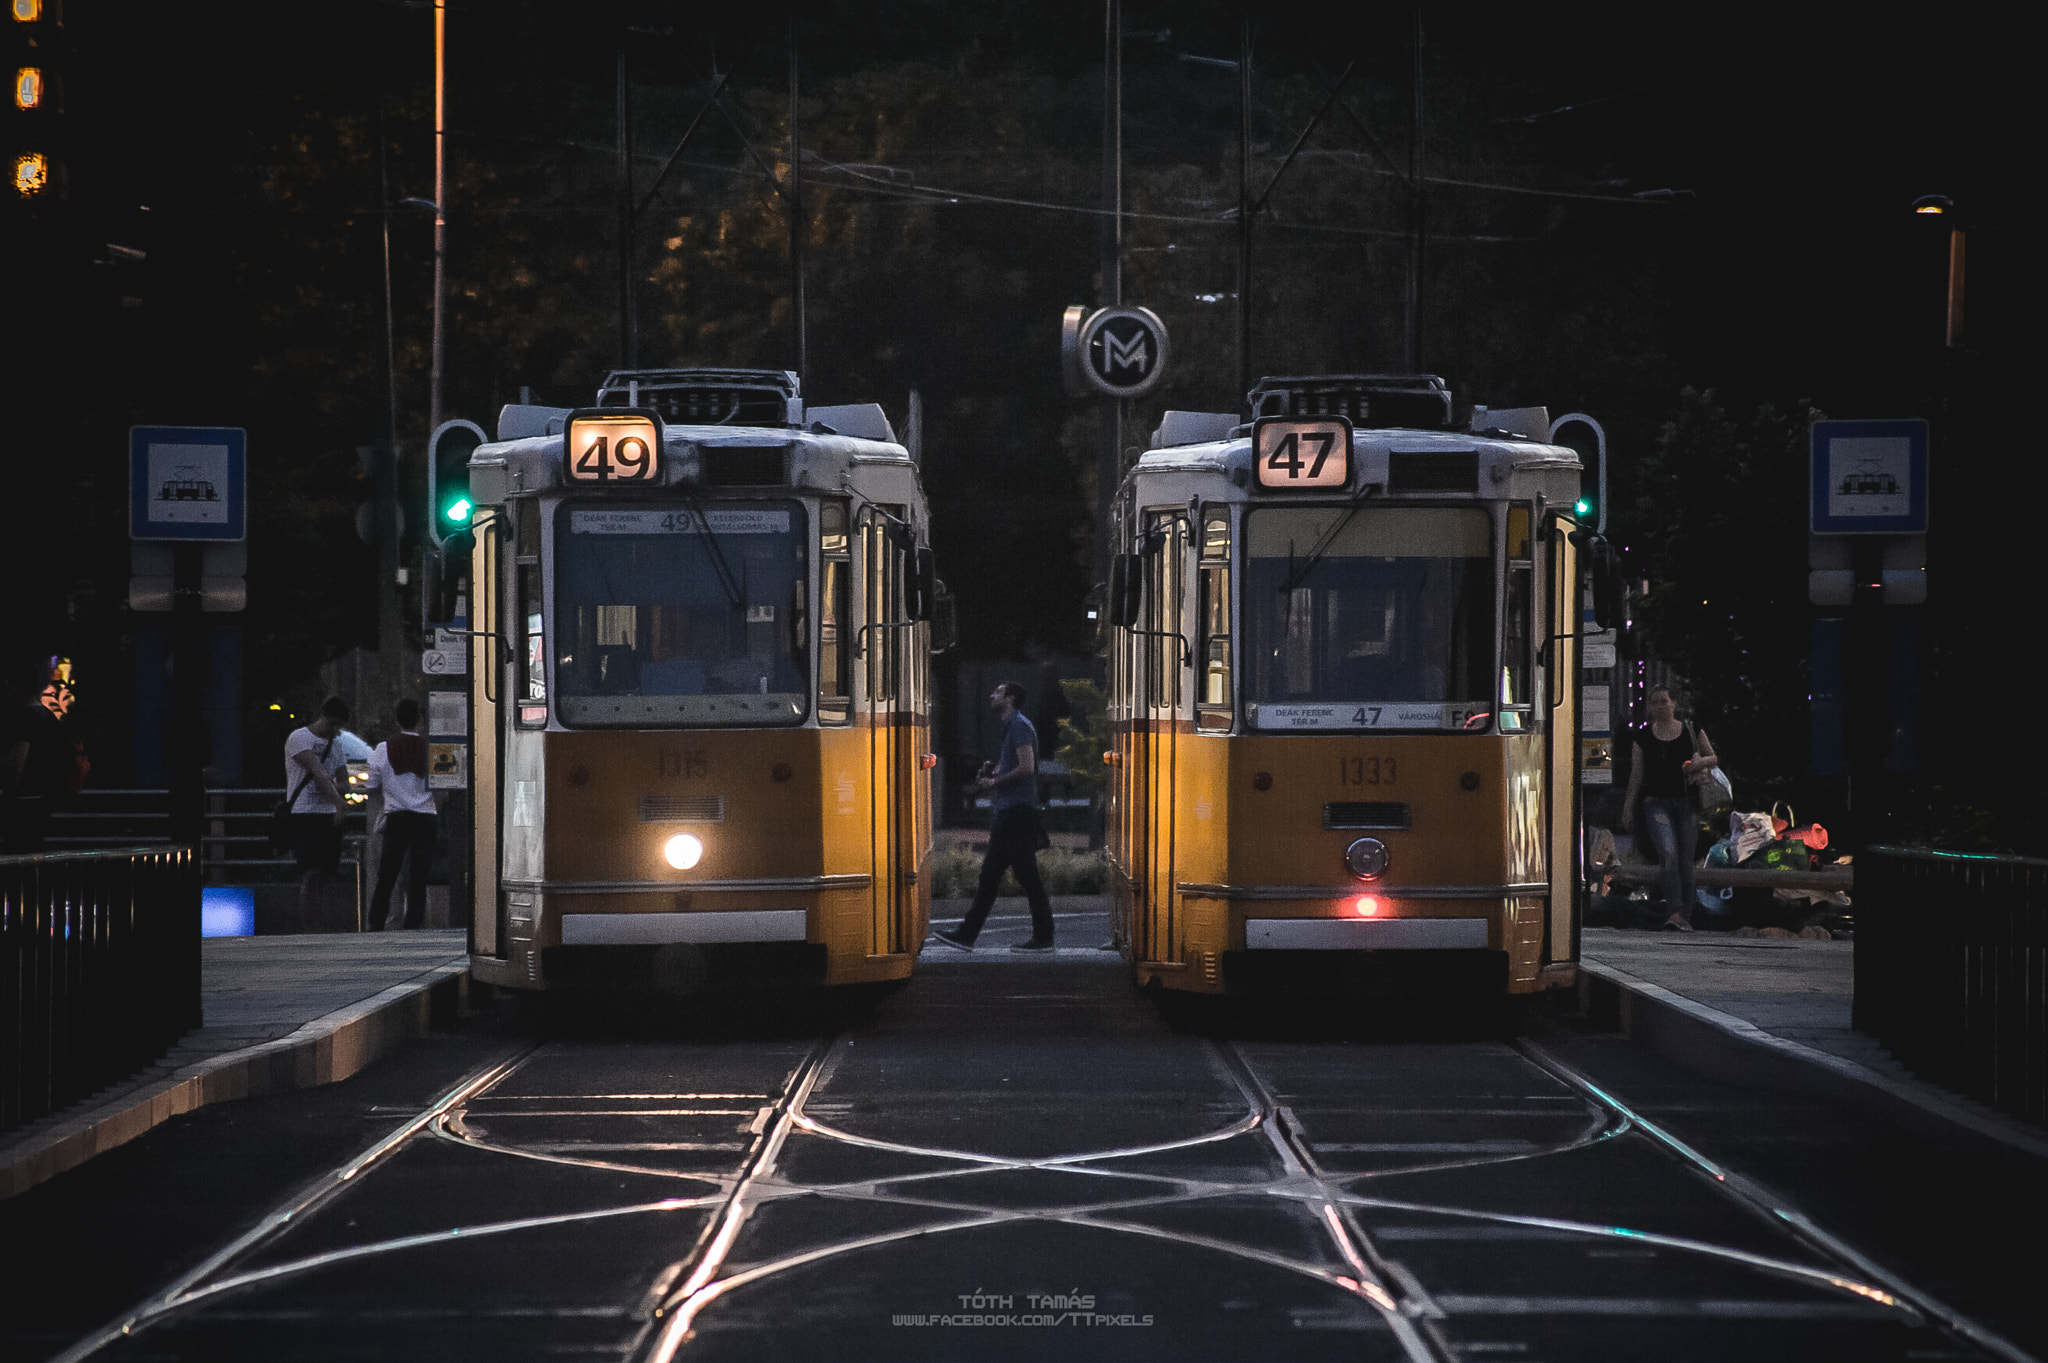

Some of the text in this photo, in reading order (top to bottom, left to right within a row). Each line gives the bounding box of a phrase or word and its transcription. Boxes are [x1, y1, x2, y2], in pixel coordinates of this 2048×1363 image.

[576, 436, 650, 480] 49
[1268, 432, 1335, 479] 47
[660, 513, 690, 532] 49
[1301, 709, 1334, 717] FERENC
[1310, 718, 1319, 726] M
[1352, 707, 1382, 726] 47
[1340, 756, 1397, 786] 1333
